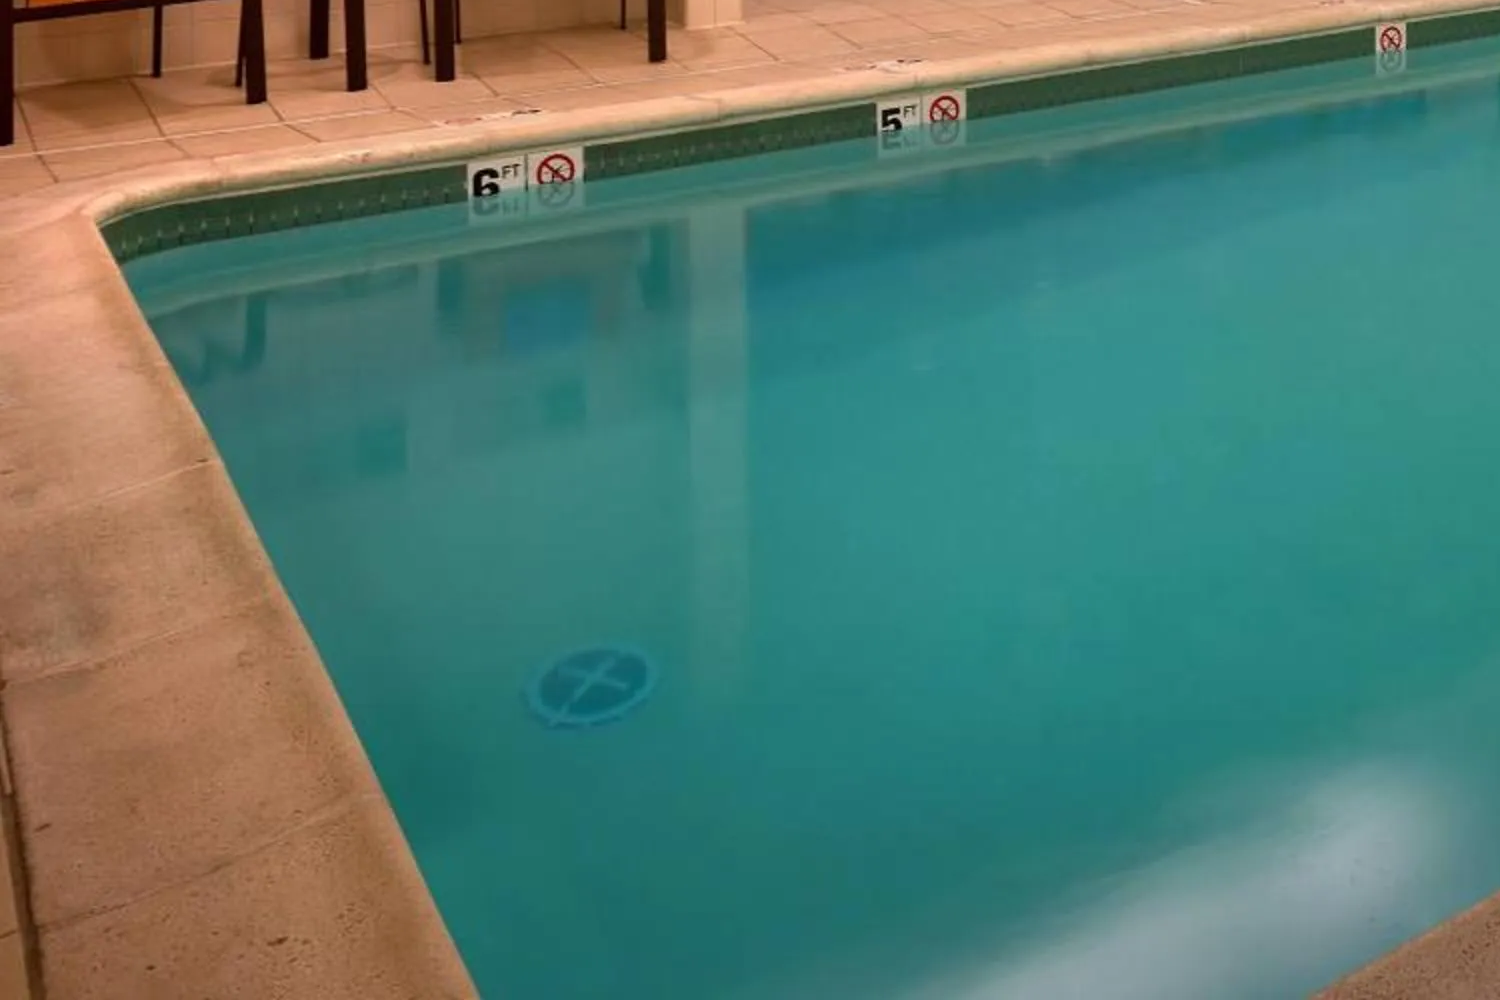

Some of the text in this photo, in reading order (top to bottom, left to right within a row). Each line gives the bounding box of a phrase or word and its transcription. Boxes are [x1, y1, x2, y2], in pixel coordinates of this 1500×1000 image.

[881, 107, 902, 133] 5
[473, 163, 521, 197] 6 FT
